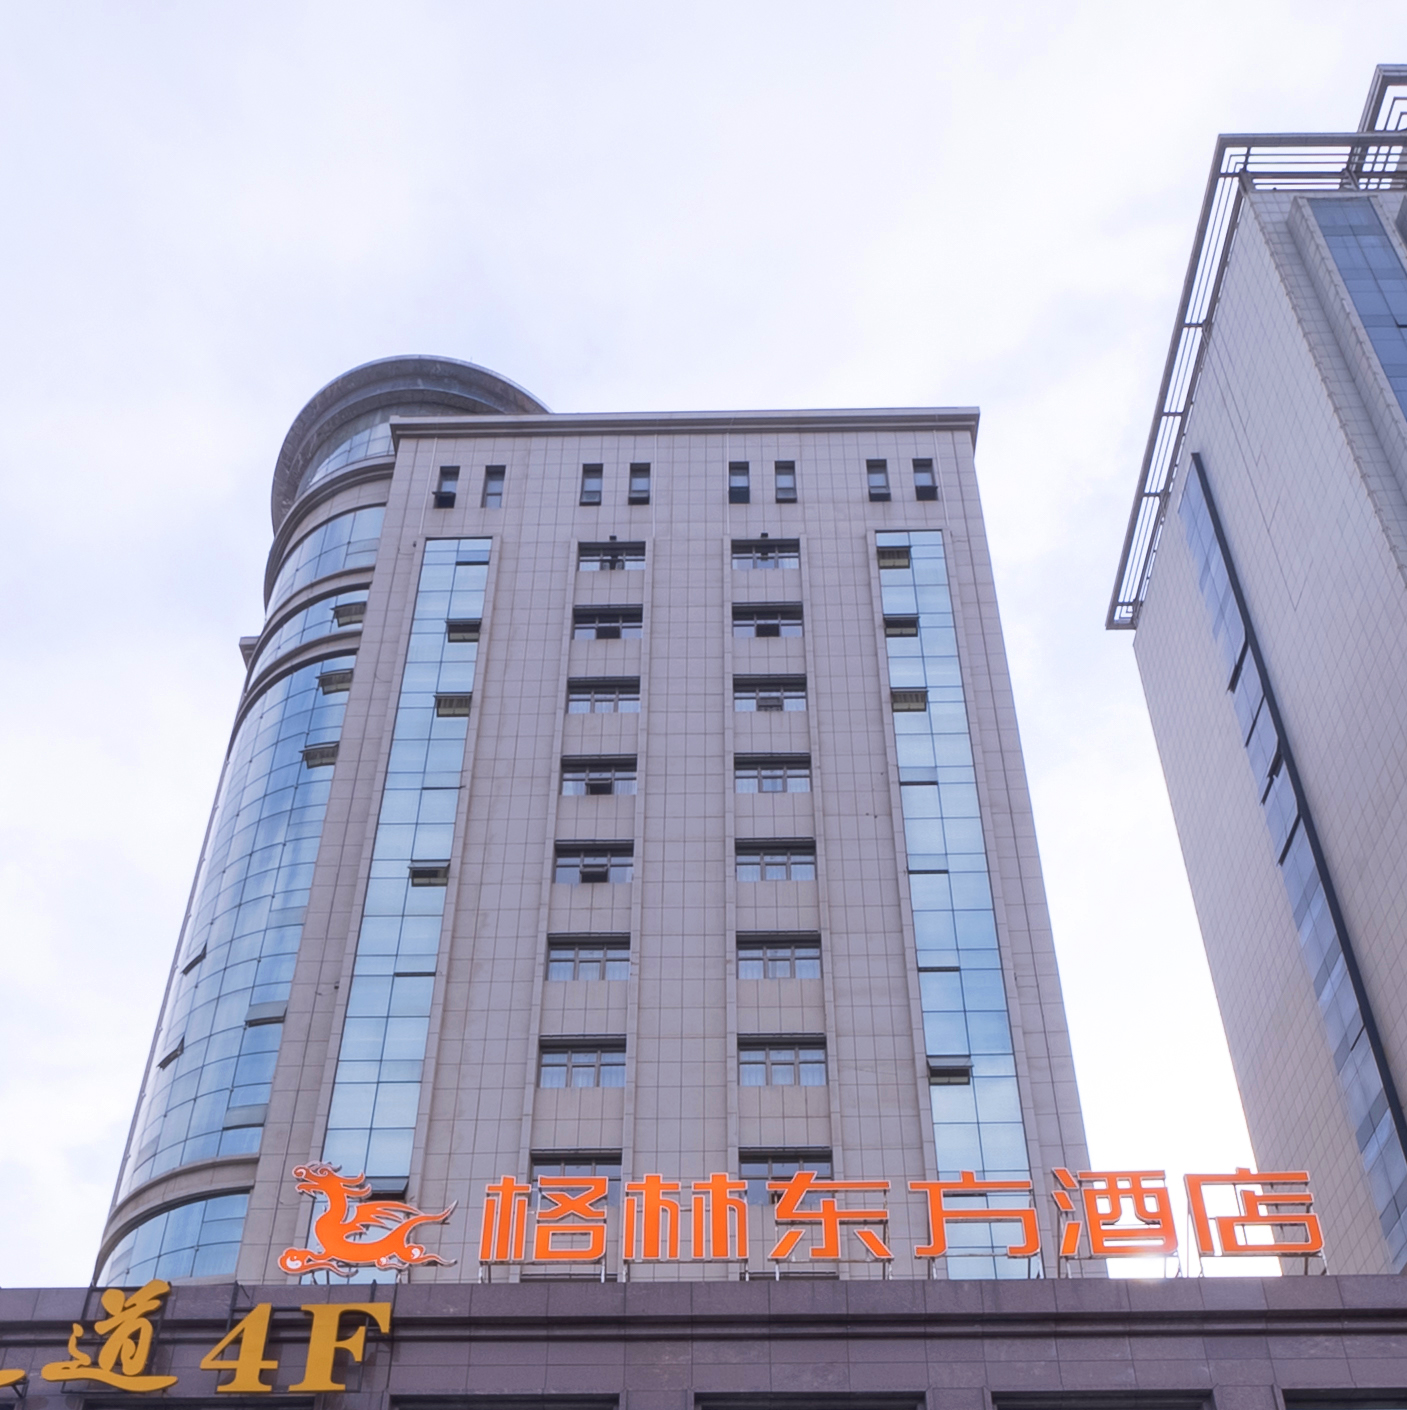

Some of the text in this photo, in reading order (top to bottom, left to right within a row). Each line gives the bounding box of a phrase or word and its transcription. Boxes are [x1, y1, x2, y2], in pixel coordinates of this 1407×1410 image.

[478, 1167, 1325, 1261] 格林东方酒店
